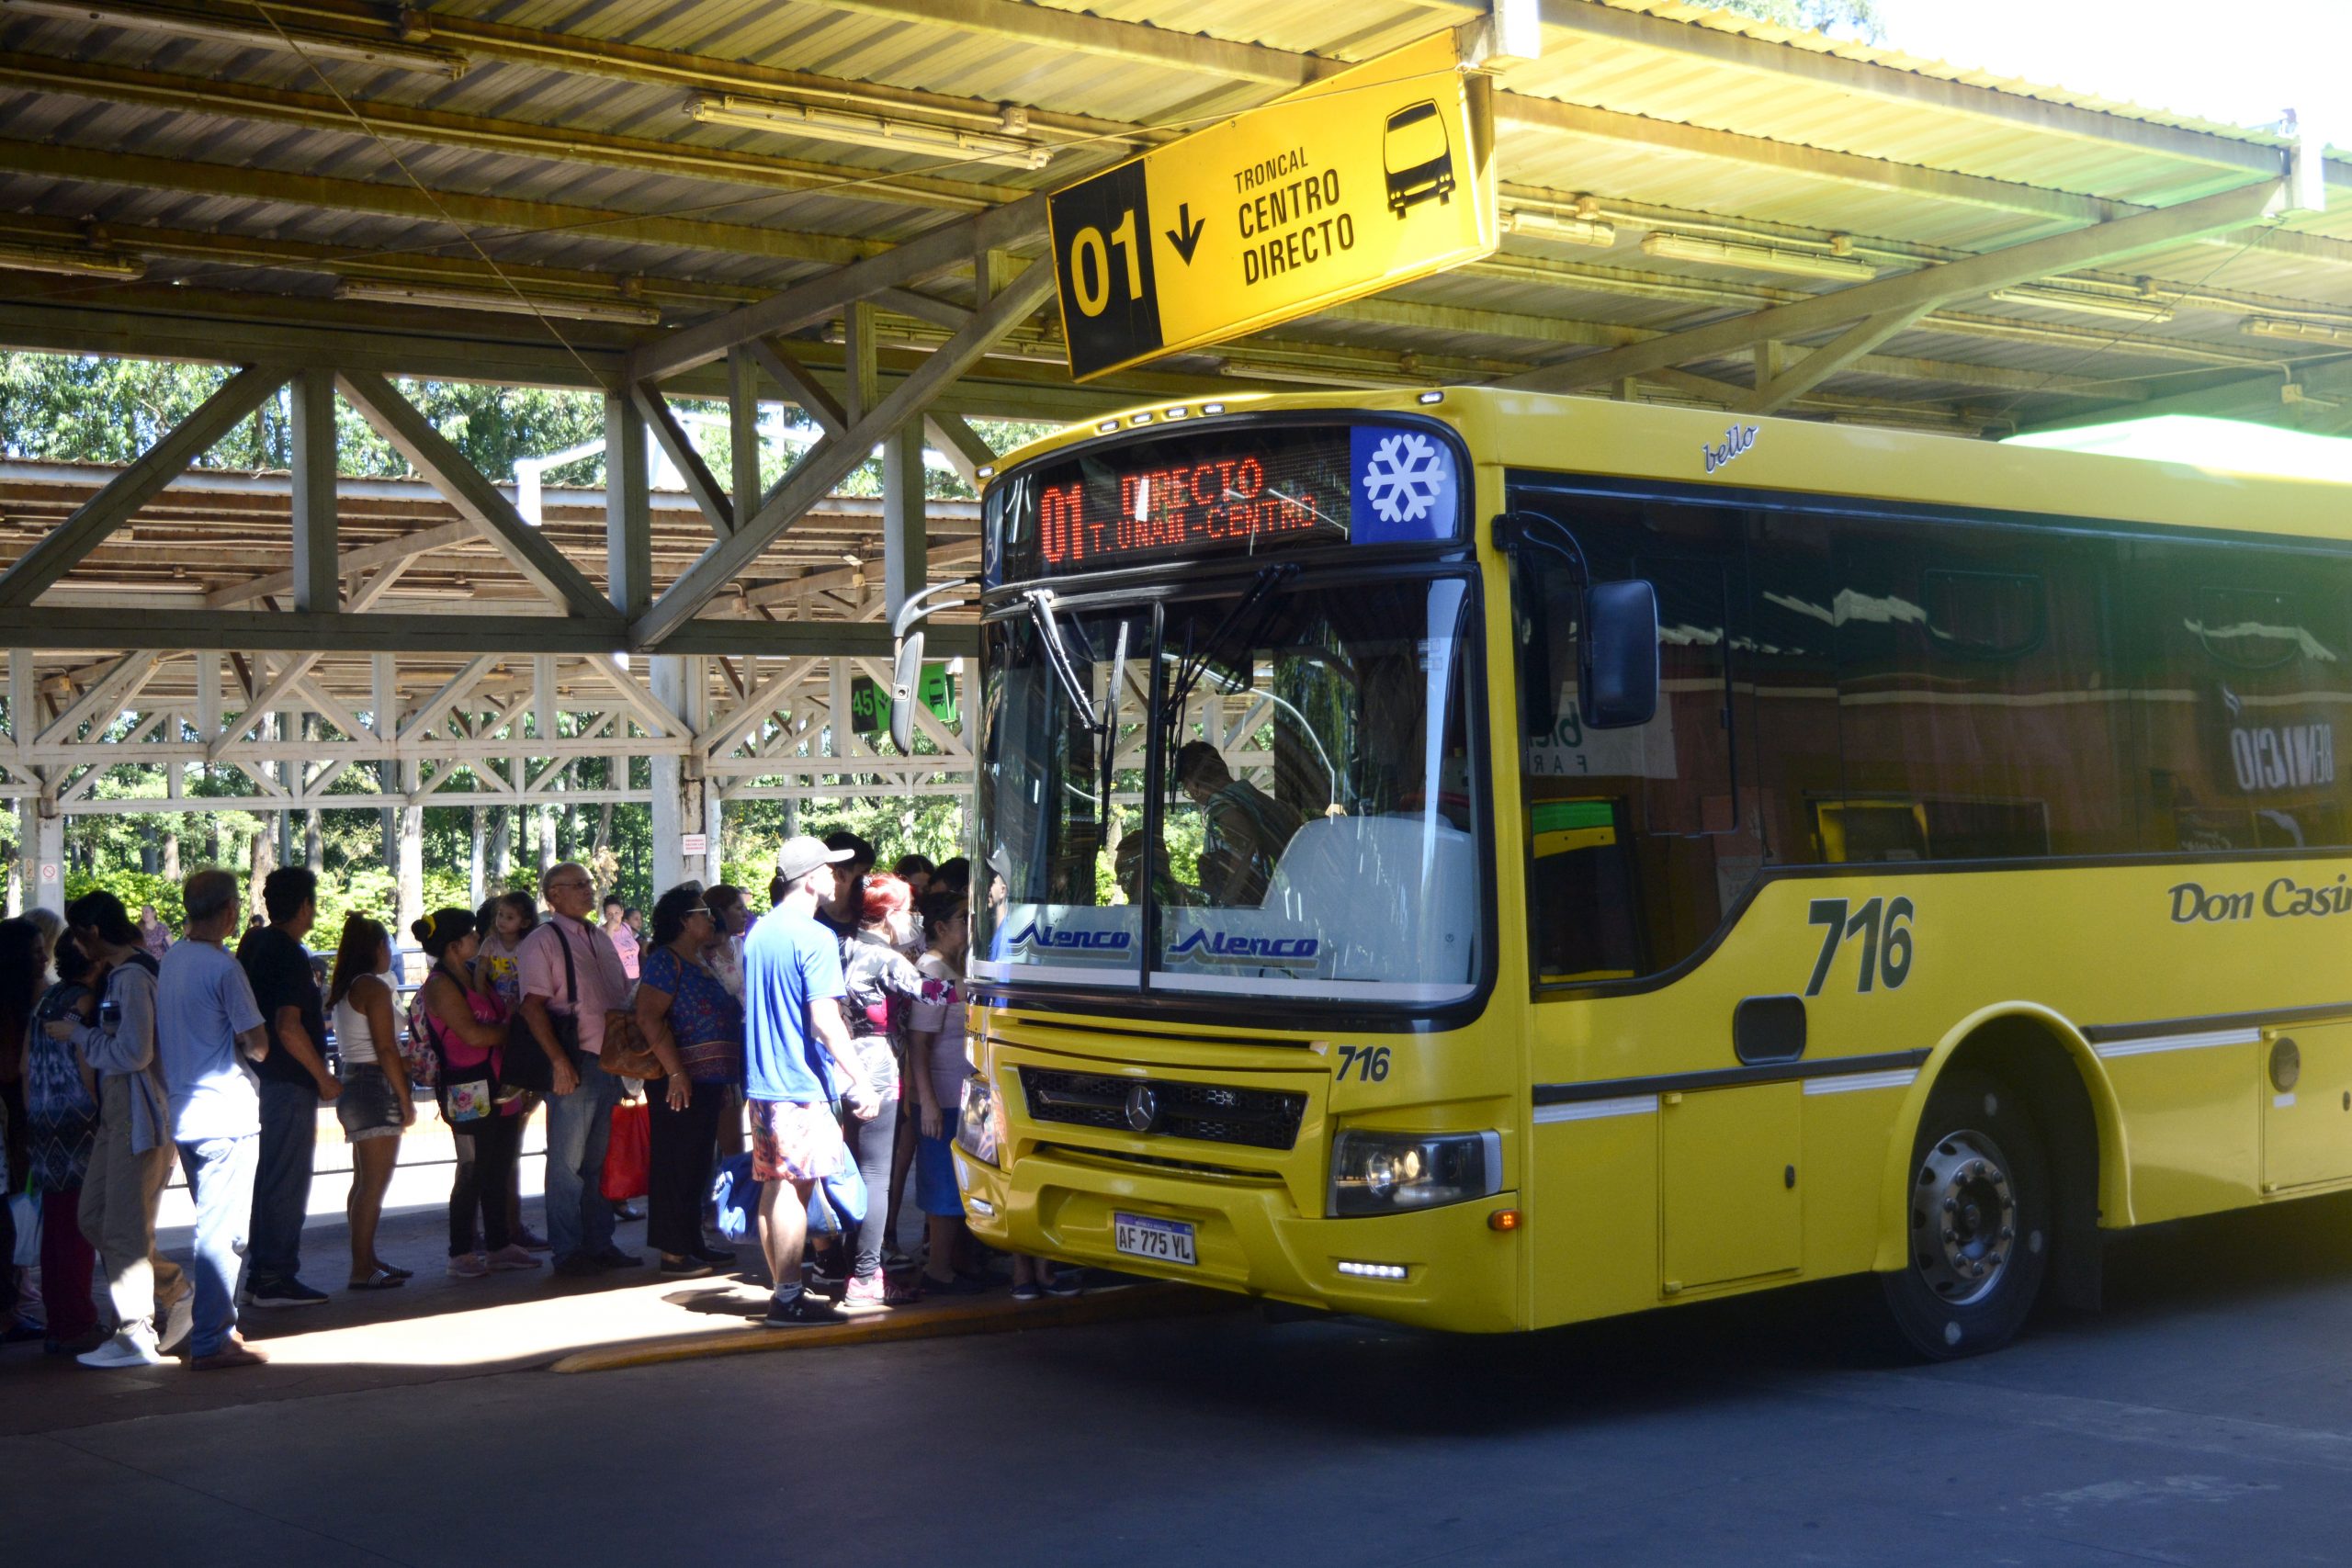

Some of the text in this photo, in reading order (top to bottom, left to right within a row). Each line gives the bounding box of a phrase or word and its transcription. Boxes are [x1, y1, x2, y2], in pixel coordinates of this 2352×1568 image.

[1234, 147, 1308, 193] TRONCAL
[1238, 168, 1340, 239] CENTRO
[1070, 209, 1142, 317] 01
[1243, 213, 1354, 286] DIRECTO
[1702, 423, 1758, 474] bello
[1041, 484, 1083, 563] 01
[853, 690, 873, 716] 45
[2167, 882, 2254, 922] Don
[1009, 919, 1131, 949] Alenco
[1168, 927, 1319, 957] Alenco
[1804, 896, 1914, 997] 716
[1336, 1045, 1391, 1082] 716
[1119, 1225, 1136, 1249] AF
[1140, 1230, 1167, 1255] 775
[1172, 1235, 1190, 1259] YL
